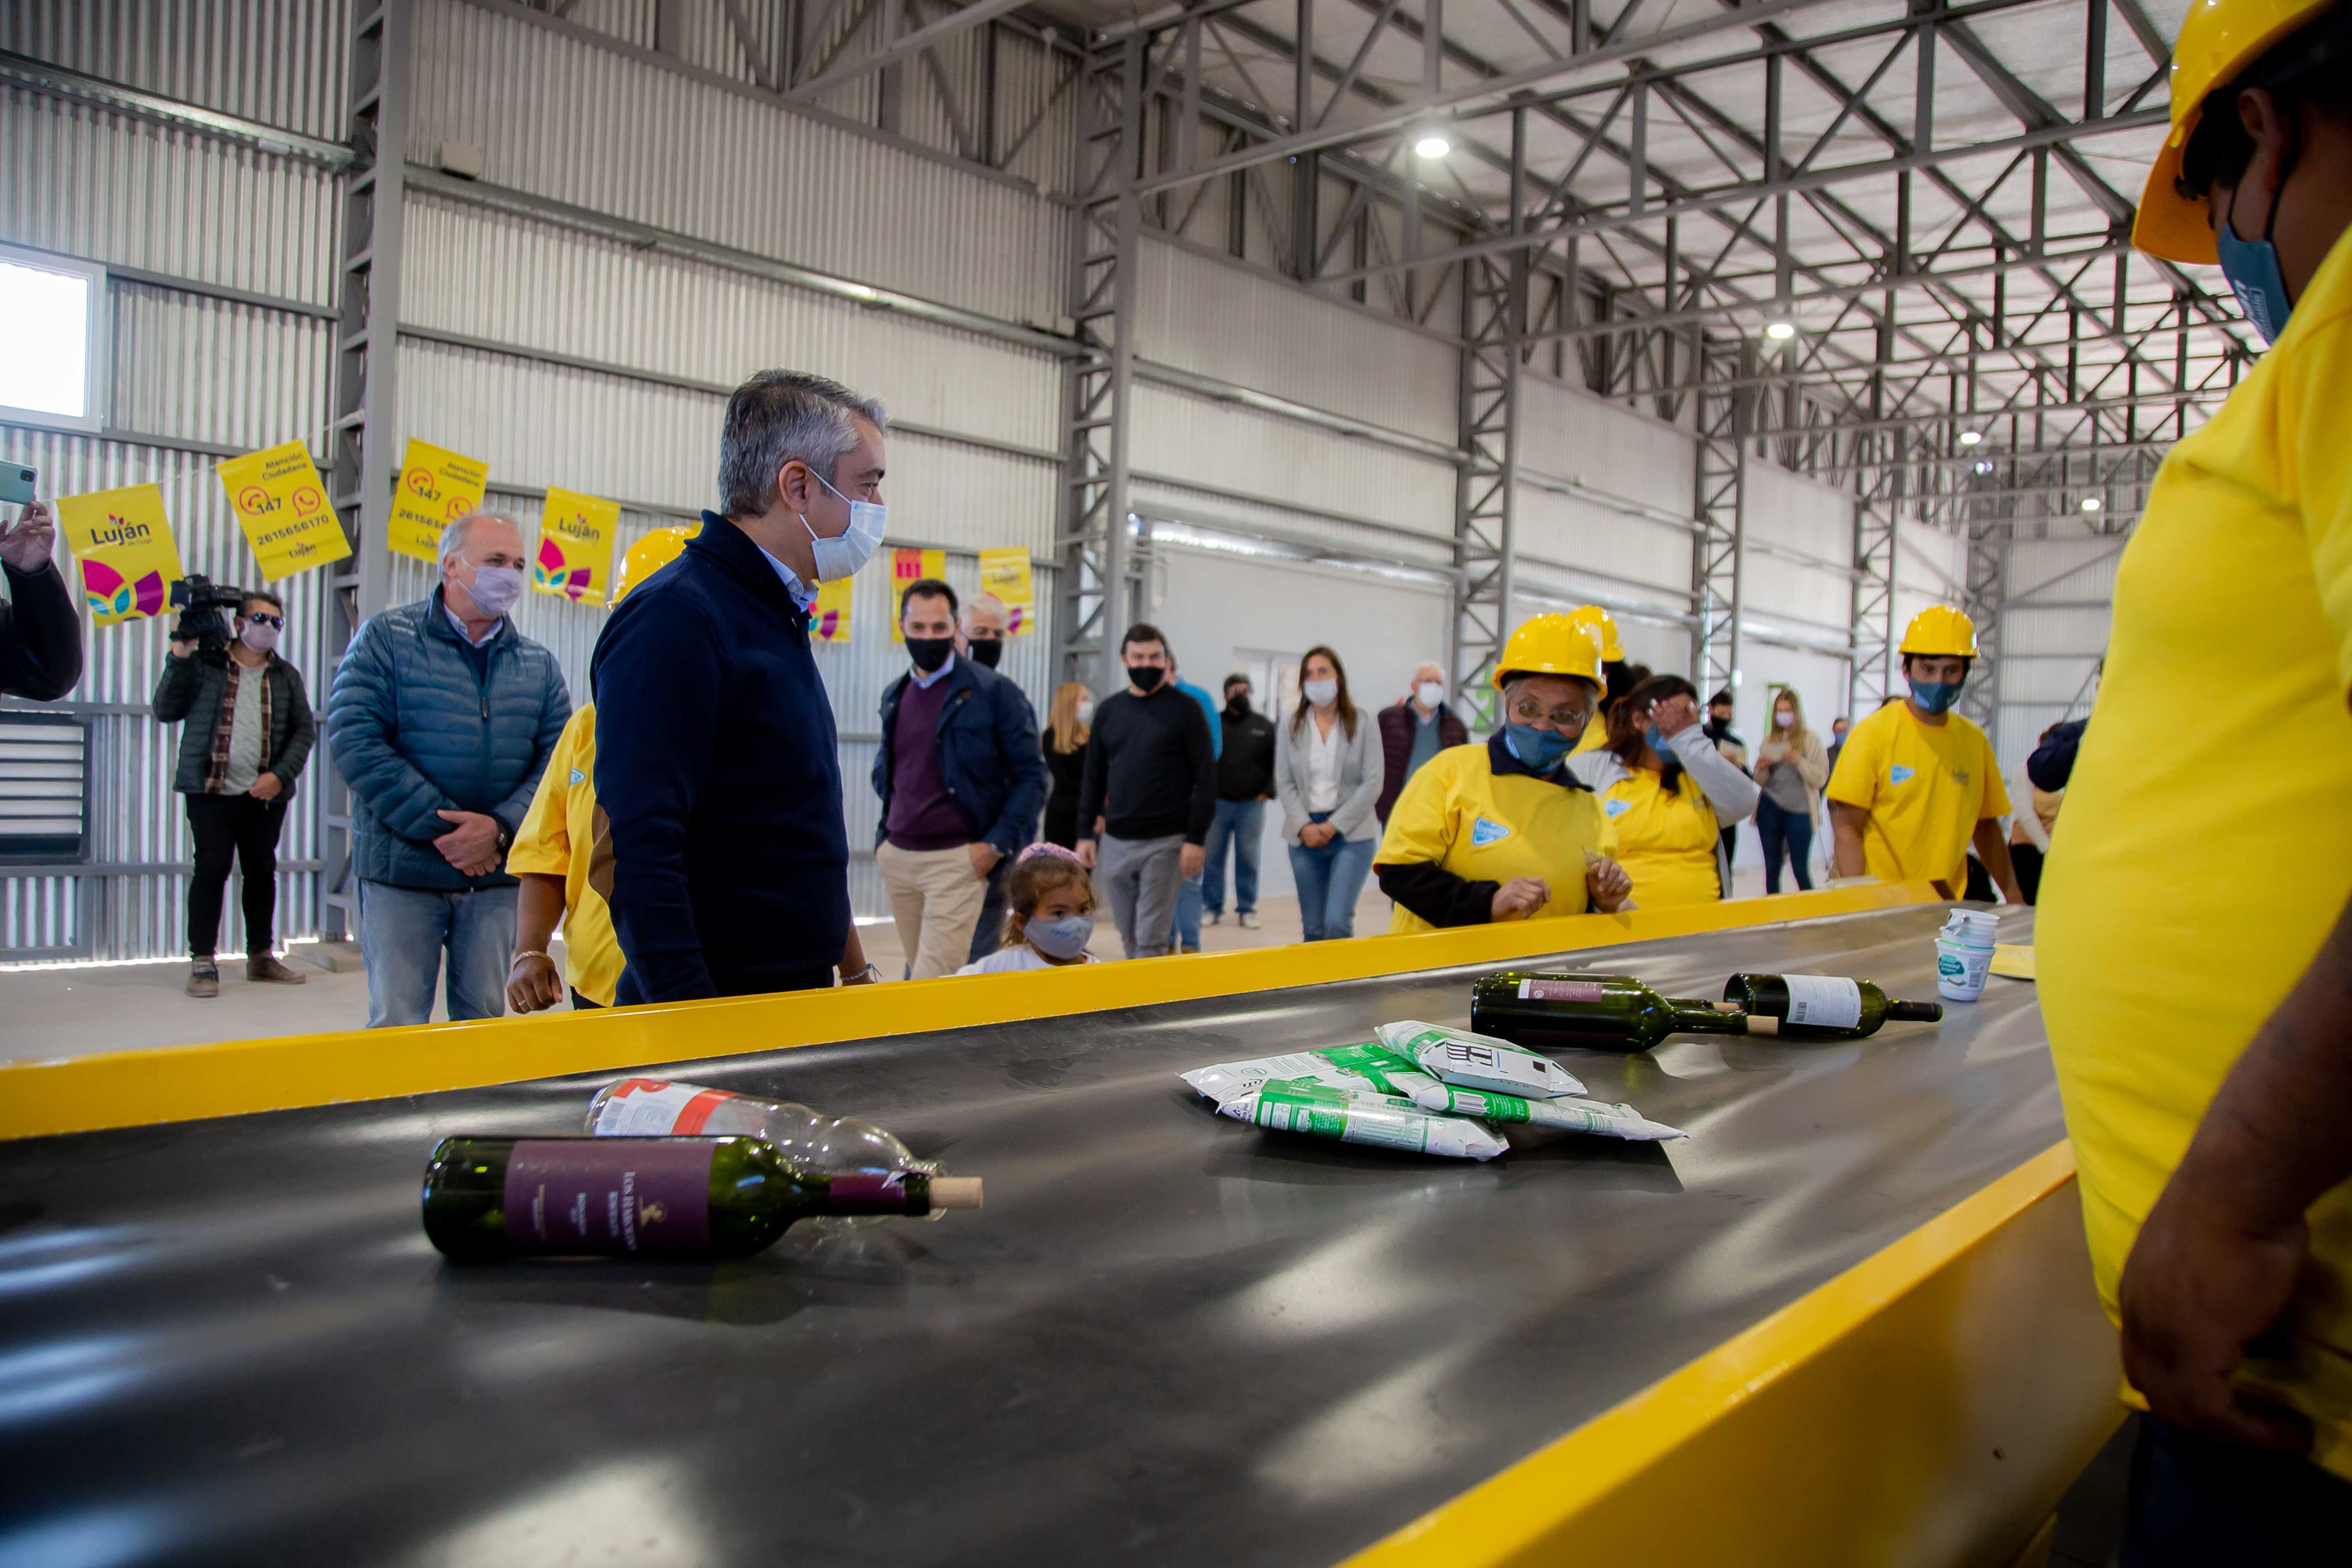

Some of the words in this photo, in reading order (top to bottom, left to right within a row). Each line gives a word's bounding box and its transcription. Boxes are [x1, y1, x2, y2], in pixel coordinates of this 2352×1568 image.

[418, 486, 441, 501] 147
[257, 497, 281, 515] 147
[90, 522, 151, 546] Luján
[559, 517, 600, 540] Luján
[288, 543, 316, 558] Luján
